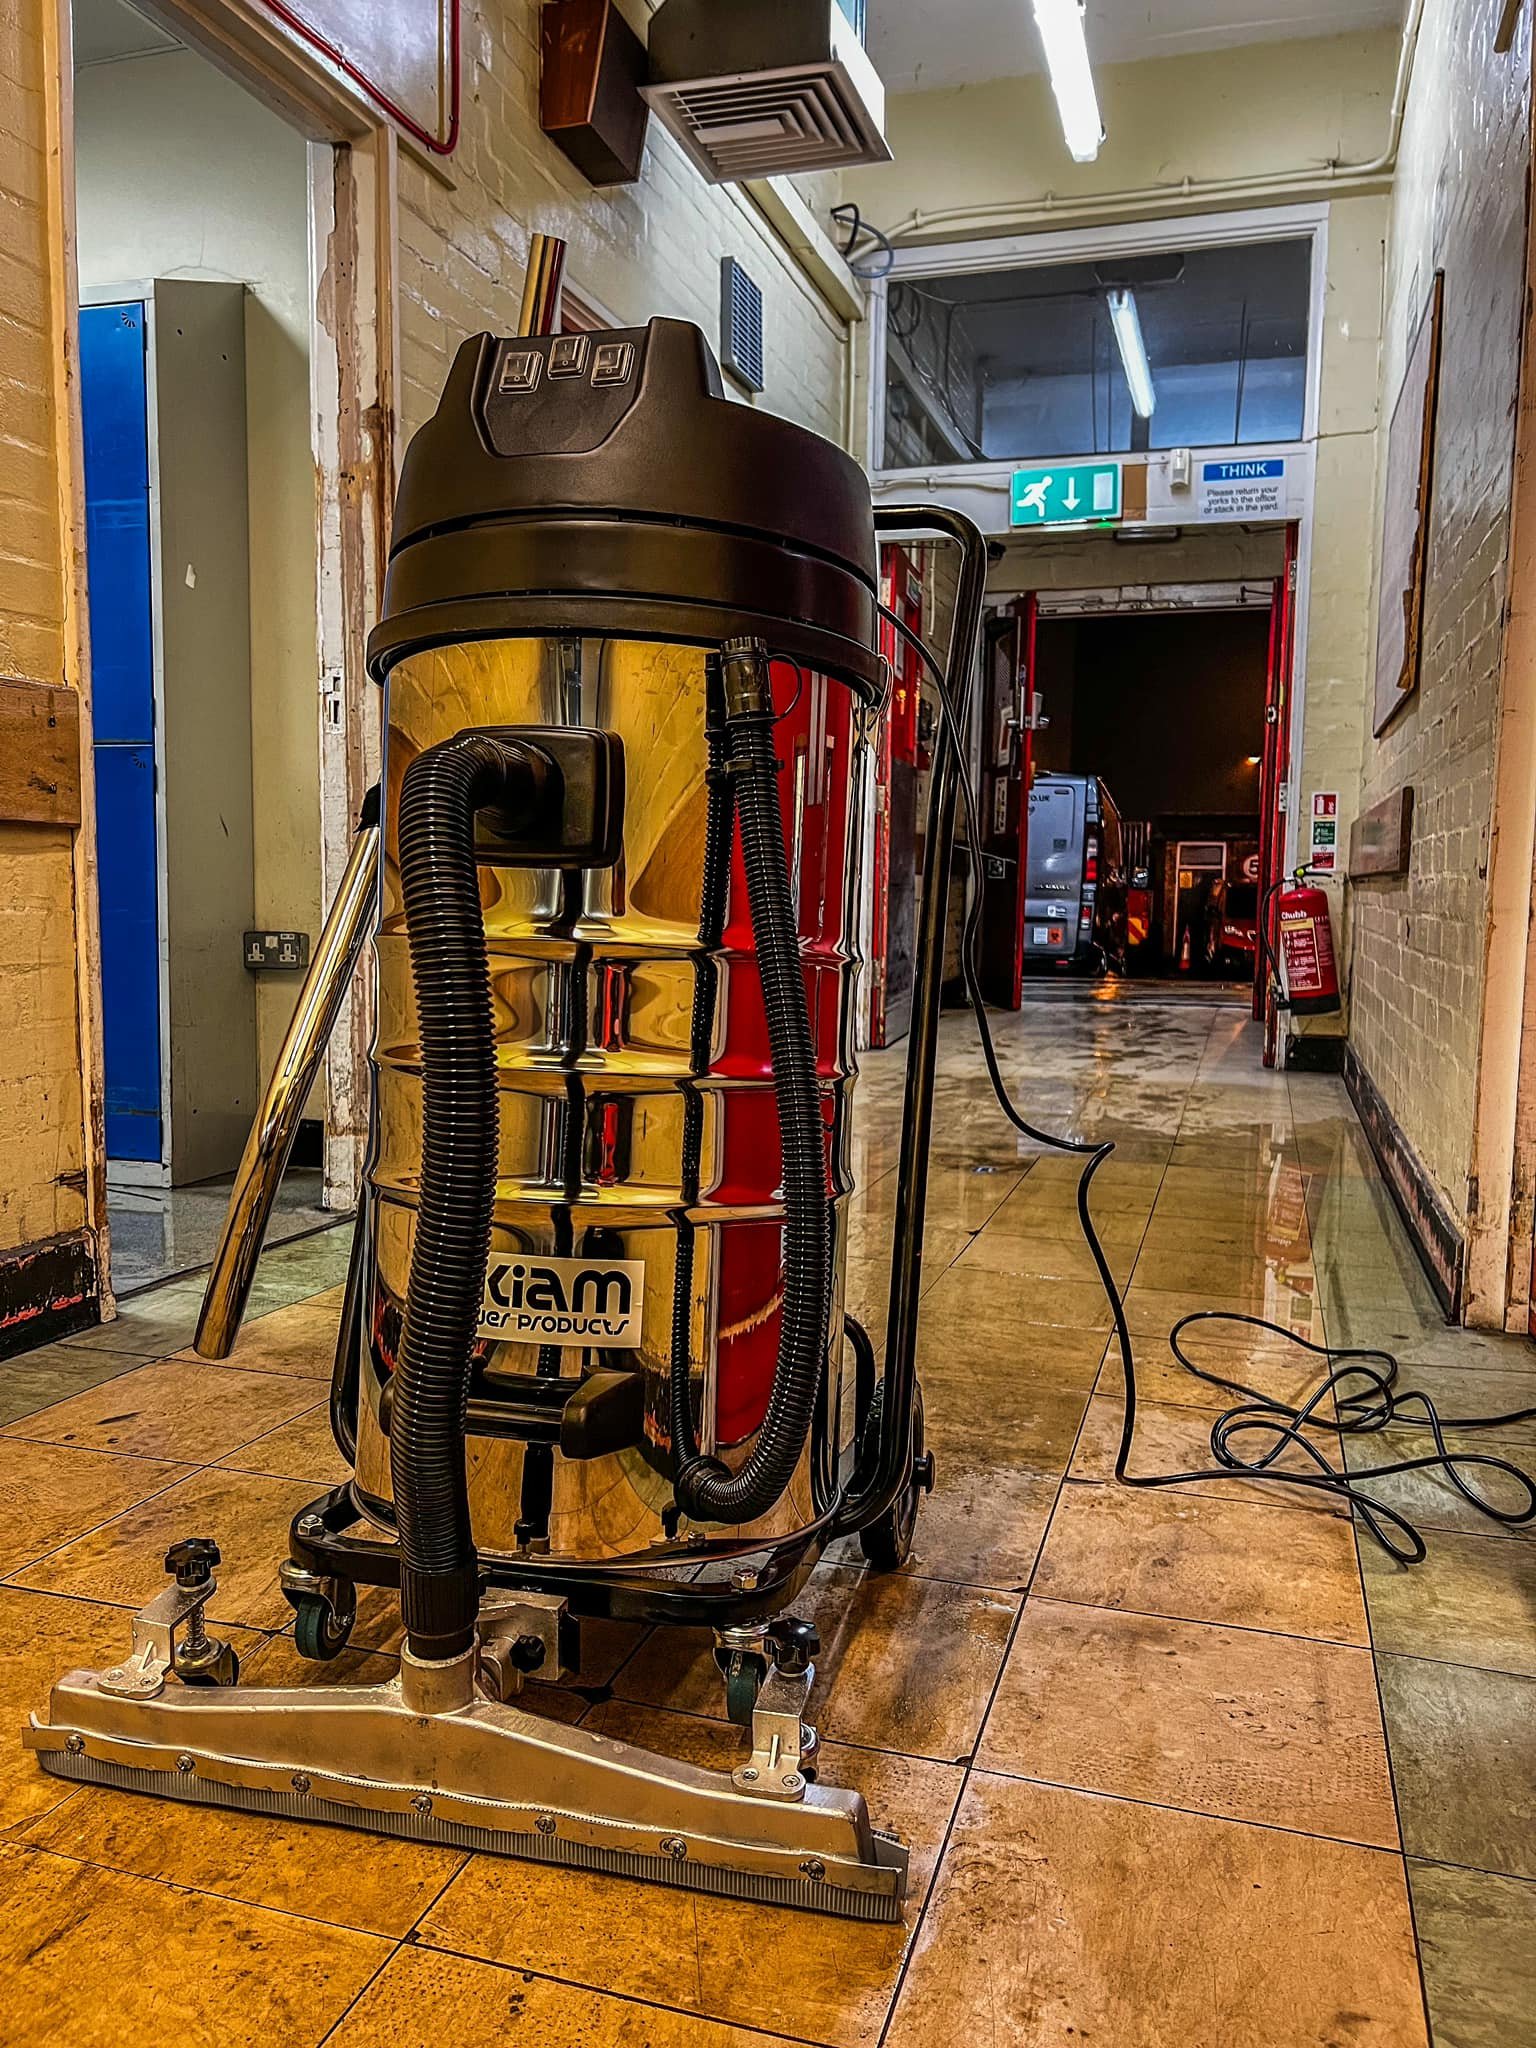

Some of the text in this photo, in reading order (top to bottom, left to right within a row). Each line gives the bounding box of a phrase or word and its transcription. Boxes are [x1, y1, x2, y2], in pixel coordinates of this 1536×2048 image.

[1220, 463, 1267, 477] THINK
[1235, 487, 1259, 495] return
[1260, 486, 1278, 495] your
[1255, 494, 1276, 502] office
[1214, 505, 1234, 513] stack
[1246, 503, 1258, 511] the
[1281, 910, 1307, 919] Chubb
